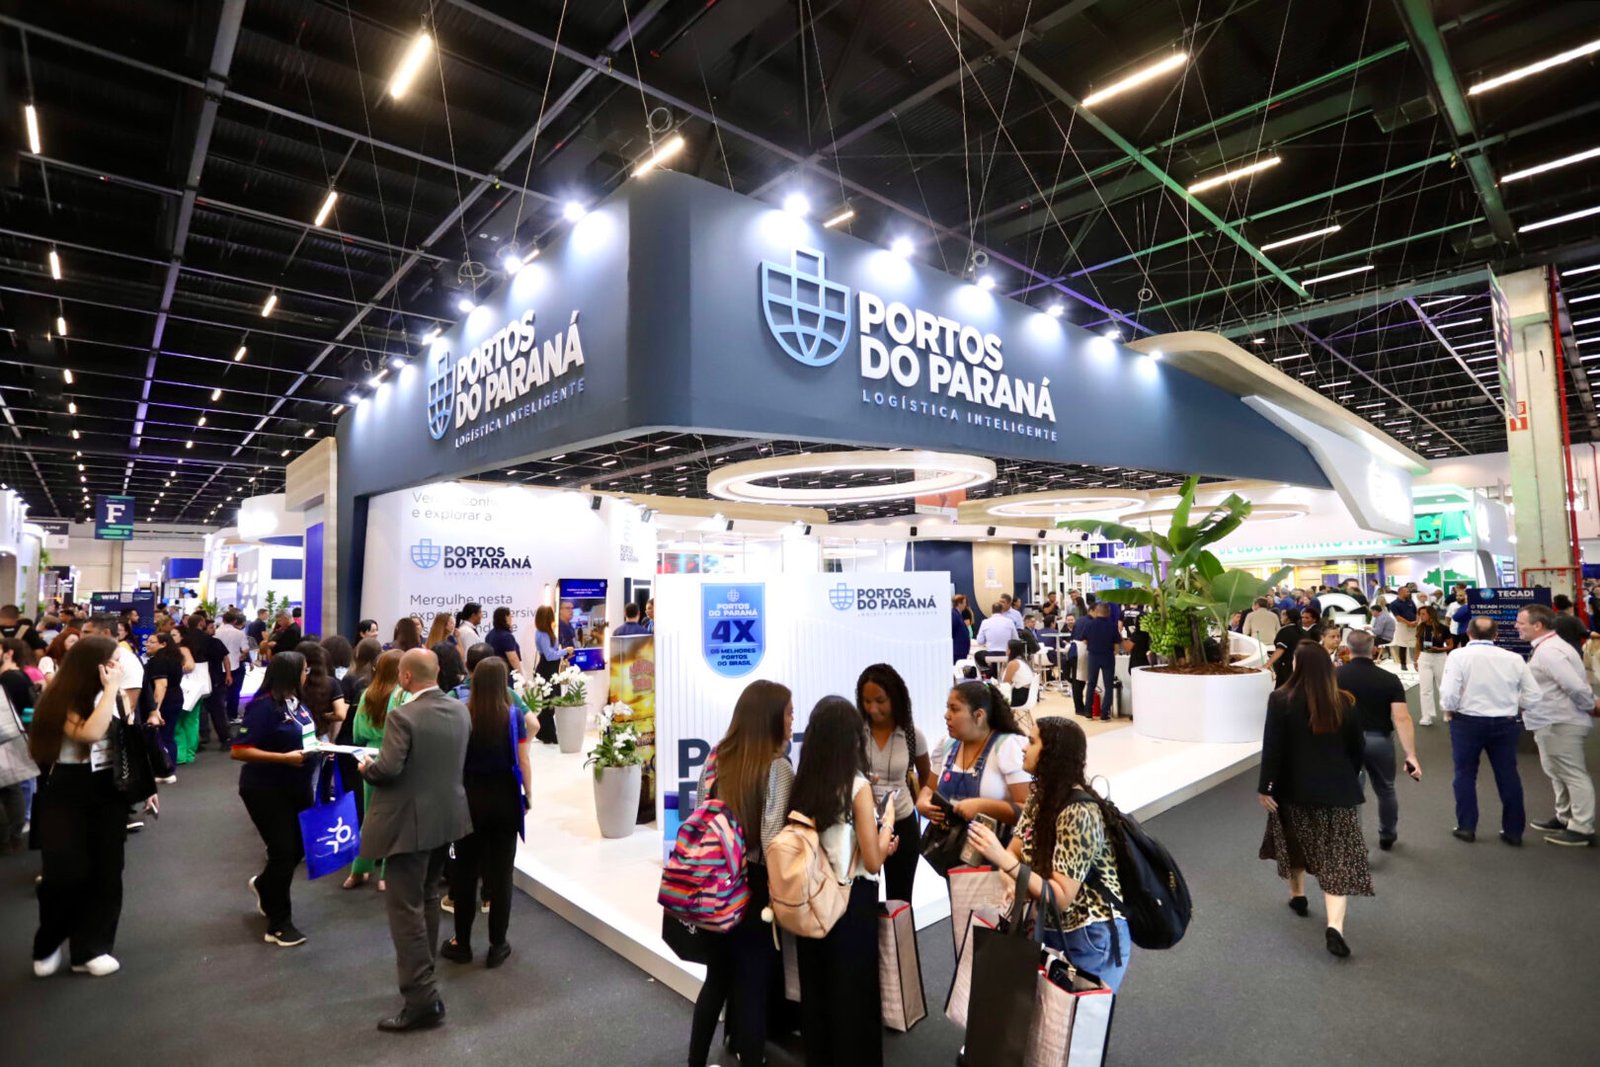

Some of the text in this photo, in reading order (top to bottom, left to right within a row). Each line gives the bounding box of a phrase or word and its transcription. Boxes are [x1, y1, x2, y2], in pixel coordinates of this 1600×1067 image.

[859, 290, 1004, 372] PORTOS
[457, 309, 536, 393] PORTOS
[455, 310, 585, 429] DO PARANÁ
[860, 334, 1056, 423] DO PARANÁ
[455, 377, 585, 448] LOGÍSTICA INTELIGENTE
[862, 389, 1058, 442] LOGÍSTICA INTELIGENTE
[105, 504, 126, 523] F
[444, 545, 505, 558] PORTOS
[444, 555, 532, 569] DO PARANÁ
[410, 594, 513, 607] Mergulhe nesta
[857, 588, 911, 599] PORTOS
[857, 595, 937, 610] DO PARANÁ
[723, 608, 758, 617] PARANÁ
[711, 620, 756, 643] 4X
